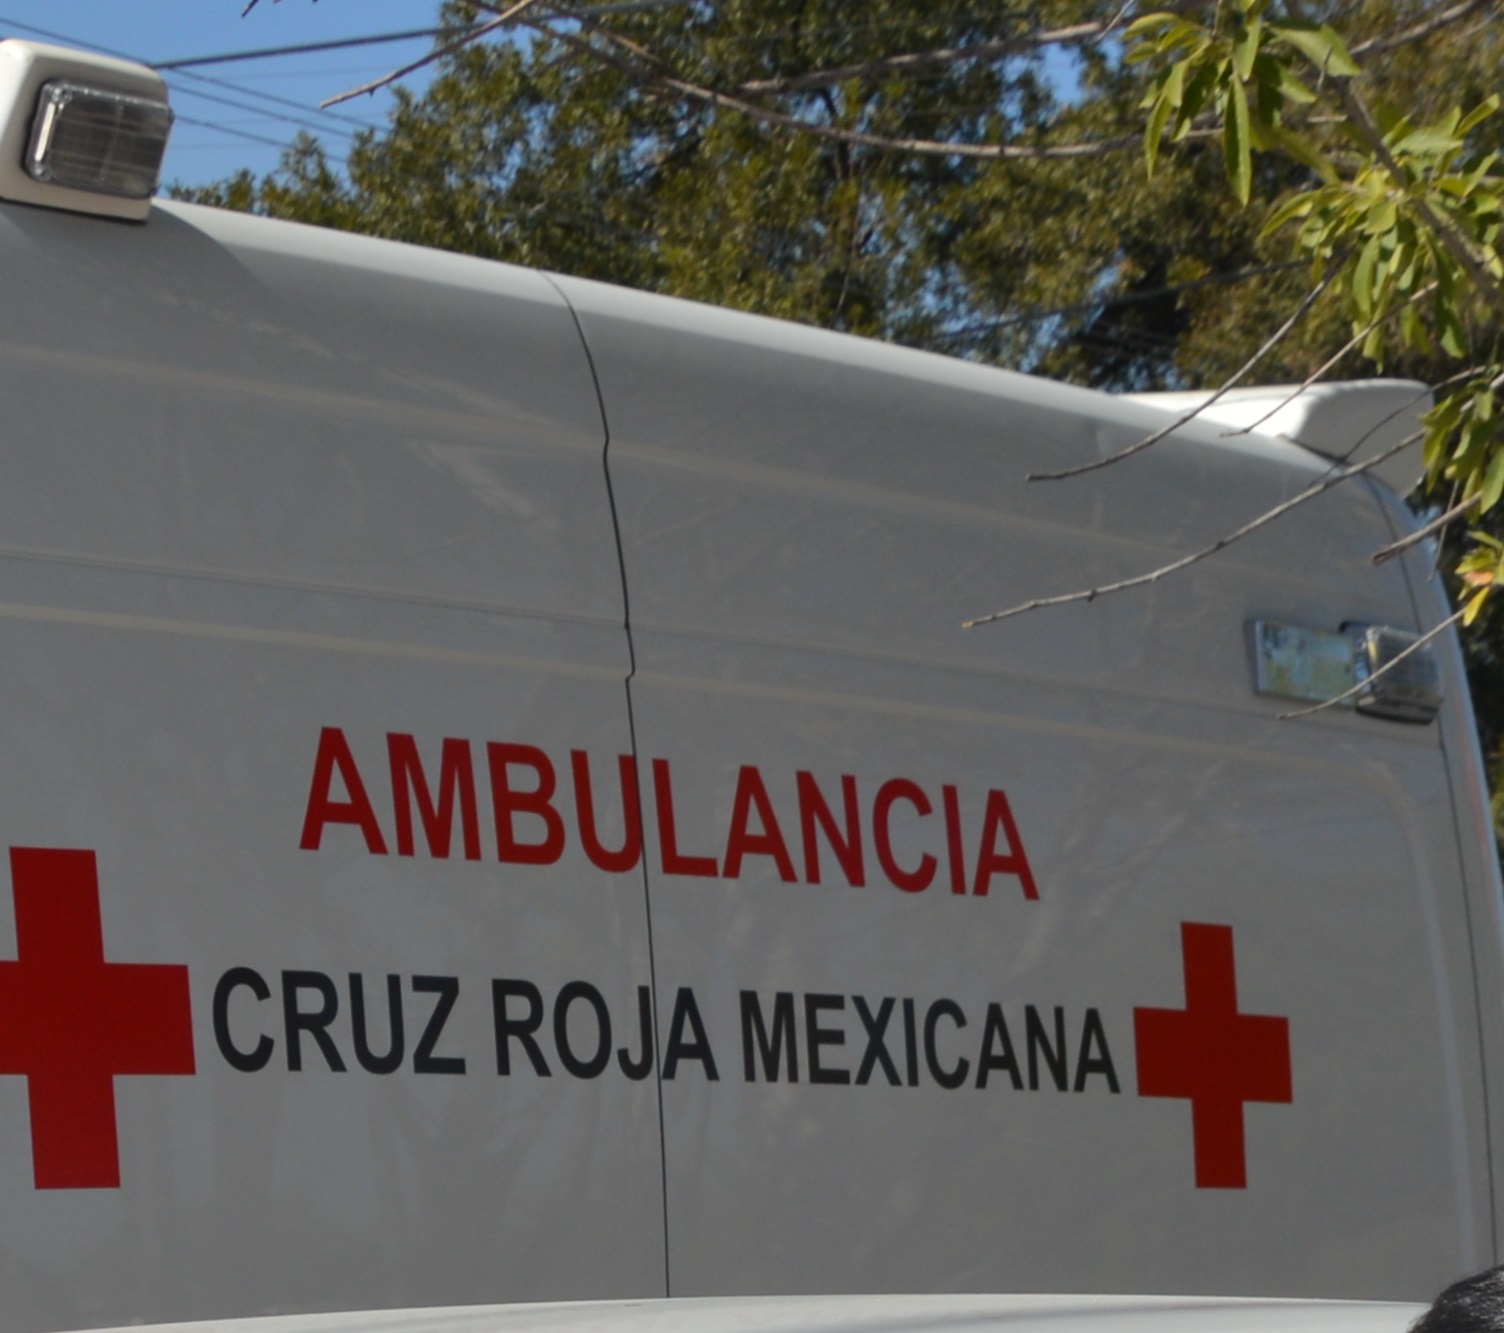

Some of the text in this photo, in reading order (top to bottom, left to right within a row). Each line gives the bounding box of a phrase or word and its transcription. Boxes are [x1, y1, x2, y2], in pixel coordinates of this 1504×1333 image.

[299, 725, 1040, 901] AMBULANCIA
[211, 965, 1121, 1095] CRUZ ROJA MEXICANA
